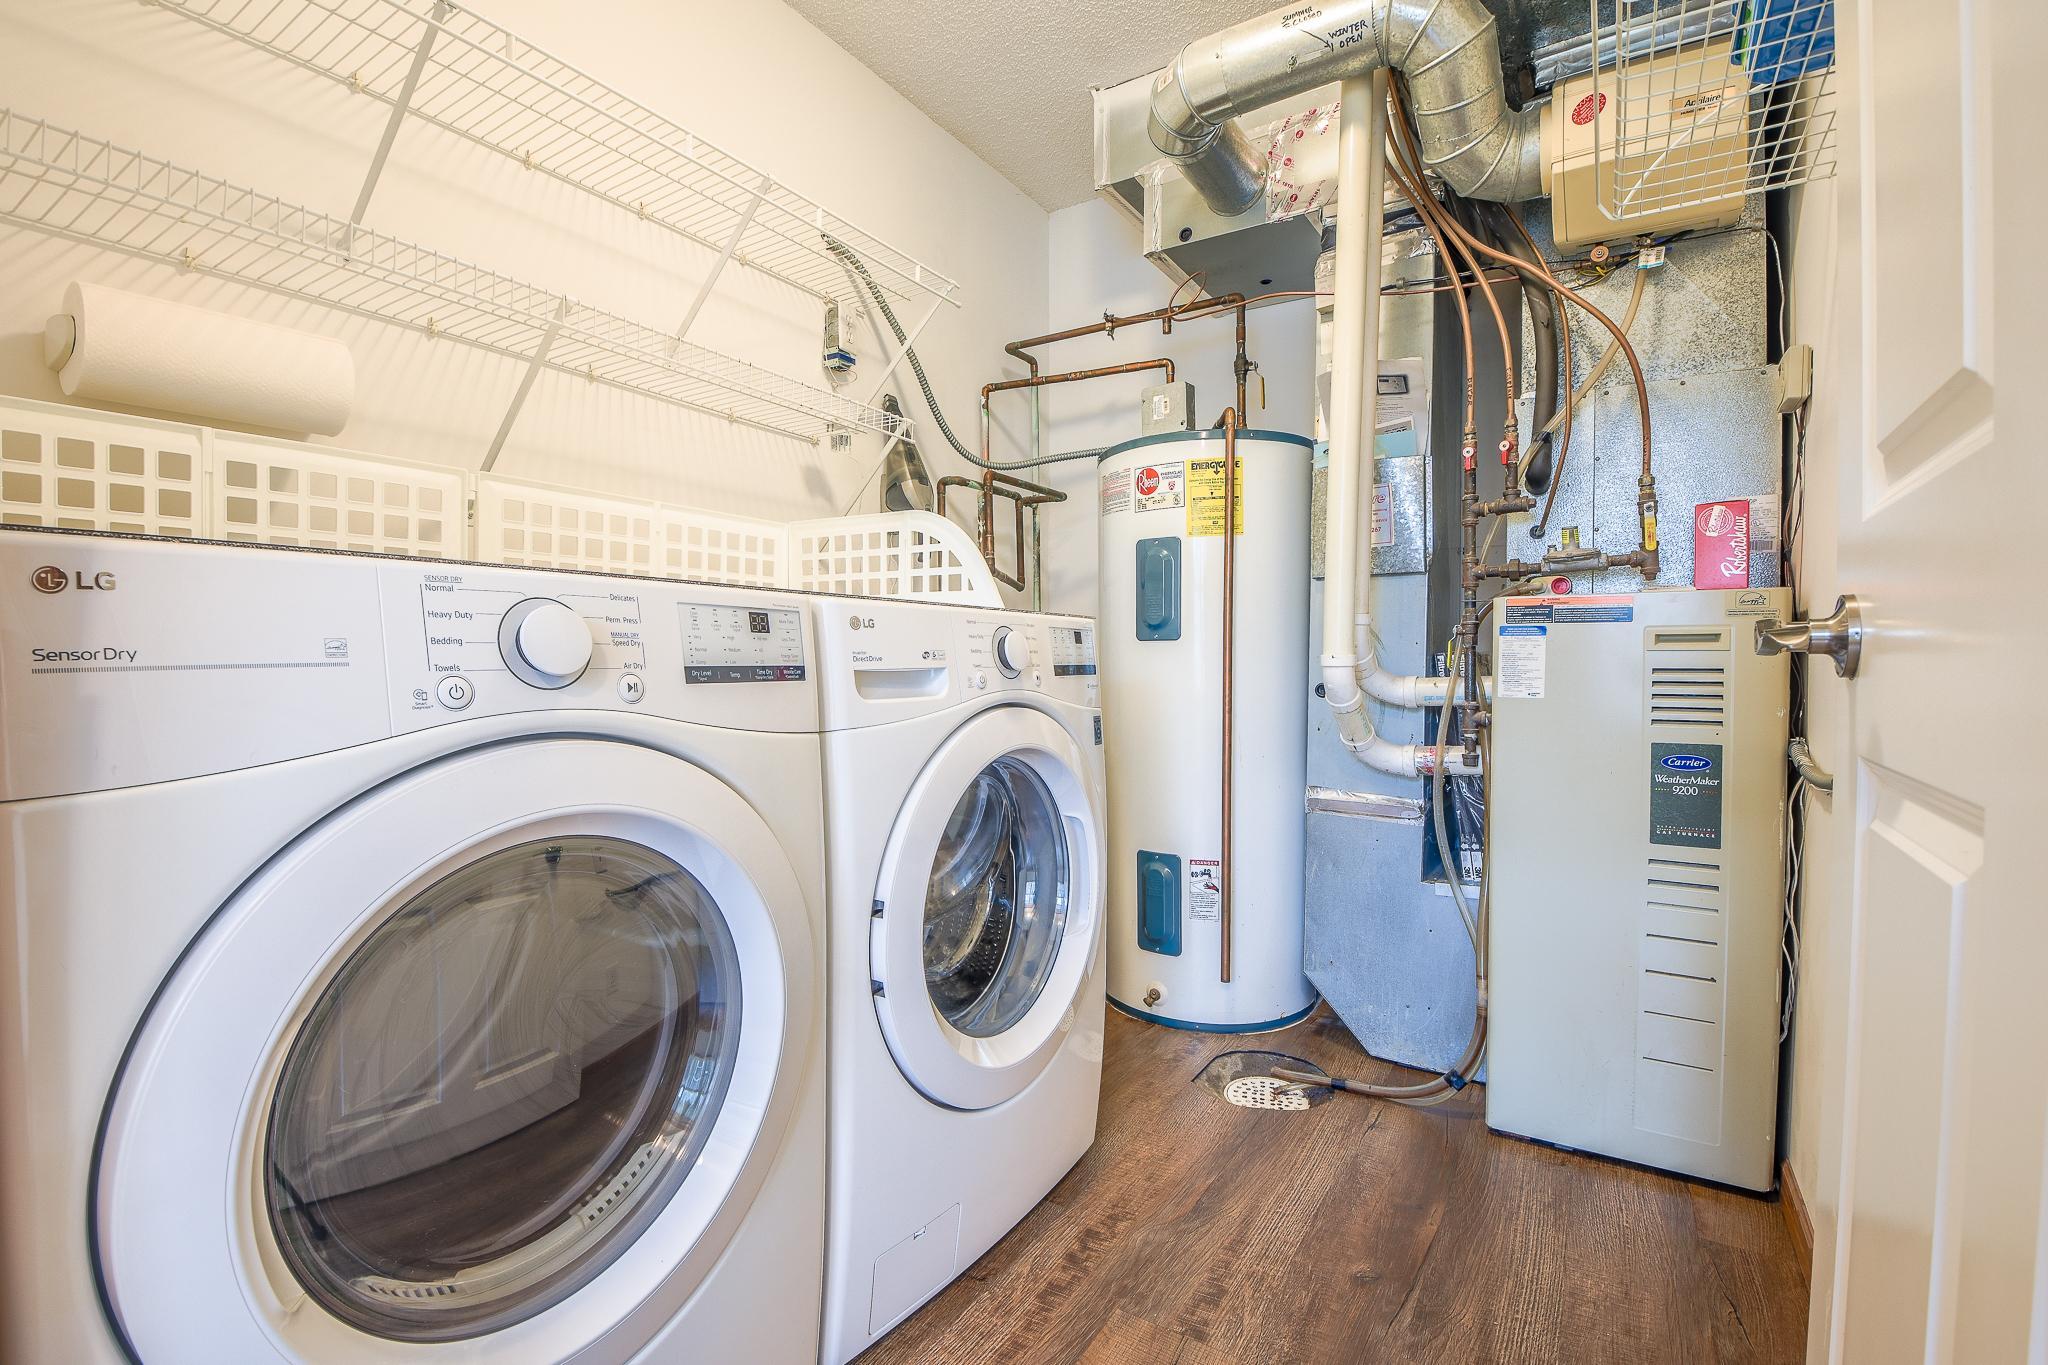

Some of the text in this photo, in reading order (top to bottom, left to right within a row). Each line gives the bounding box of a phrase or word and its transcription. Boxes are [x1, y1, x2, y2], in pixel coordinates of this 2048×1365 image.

[1281, 6, 1313, 24] SUMMER
[1328, 20, 1368, 39] WINTER
[1340, 31, 1363, 48] OPEN
[1720, 515, 1747, 577] Robertshaw
[75, 571, 116, 590] LG
[424, 584, 454, 592] Normal
[610, 594, 635, 602] Delicates
[427, 610, 473, 620] Heavy Duty
[862, 618, 875, 628] LG
[431, 637, 463, 646] Bedding
[612, 639, 640, 648] Speed Dry
[434, 664, 461, 672] Towels
[633, 662, 643, 670] Dry
[1668, 758, 1706, 767] Carrier
[1654, 774, 1720, 786] WeatherMaker
[1672, 786, 1698, 796] 9200
[1463, 866, 1471, 880] 3M
